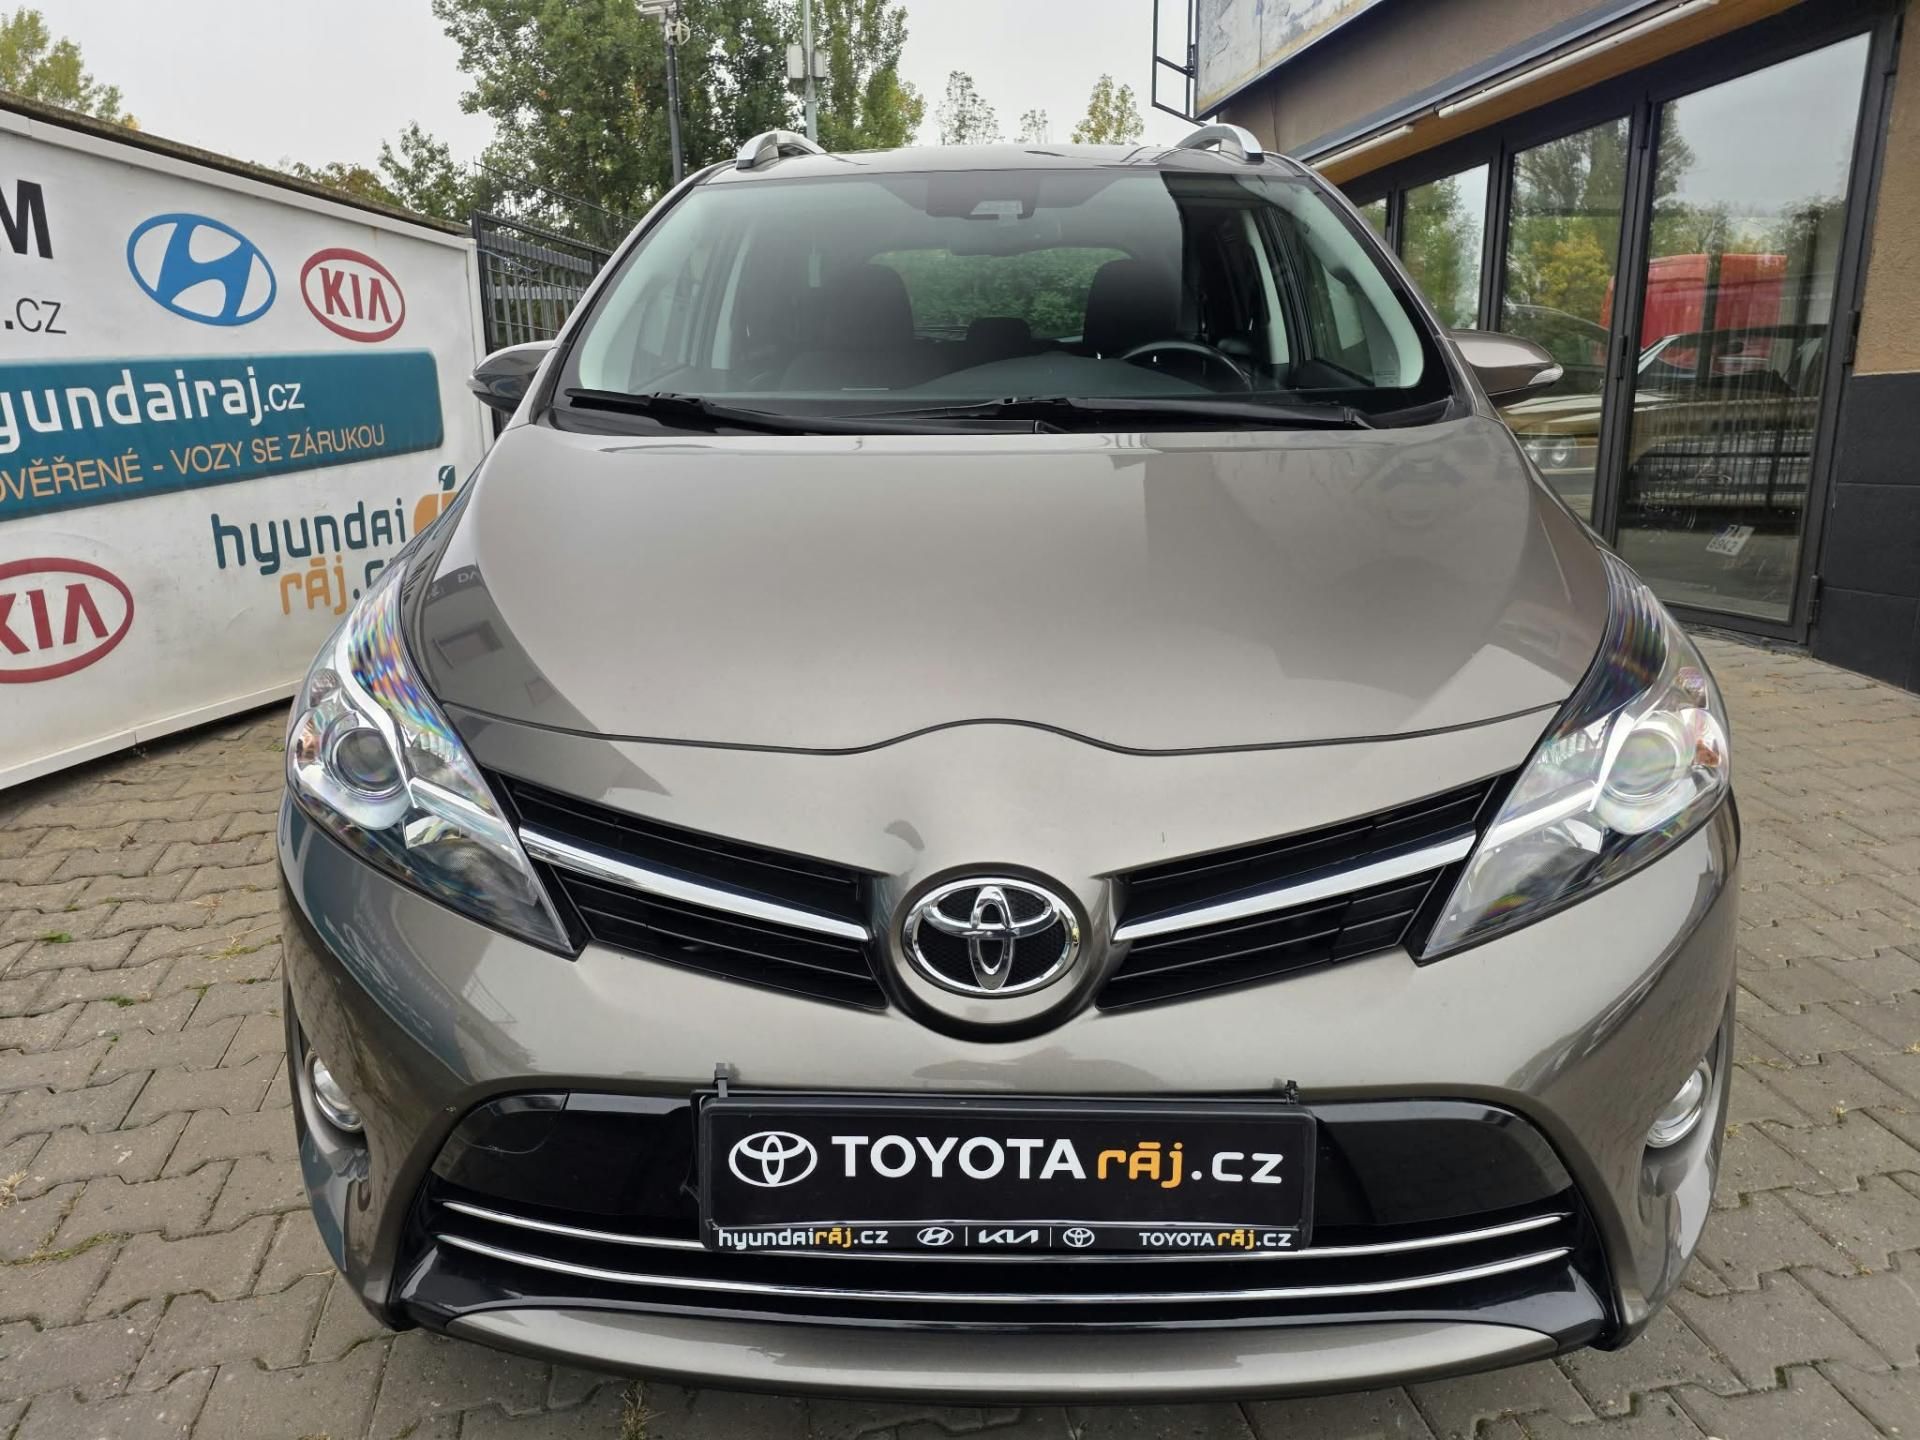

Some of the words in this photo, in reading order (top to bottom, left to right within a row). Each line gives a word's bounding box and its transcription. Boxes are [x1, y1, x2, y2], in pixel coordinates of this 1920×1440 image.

[319, 267, 393, 324] KIA
[0, 447, 143, 501] VĚŘENÉ
[170, 441, 243, 475] VOZY
[251, 436, 283, 464] SE
[288, 424, 385, 459] ZÁRUKOU
[211, 497, 406, 576] hyundai
